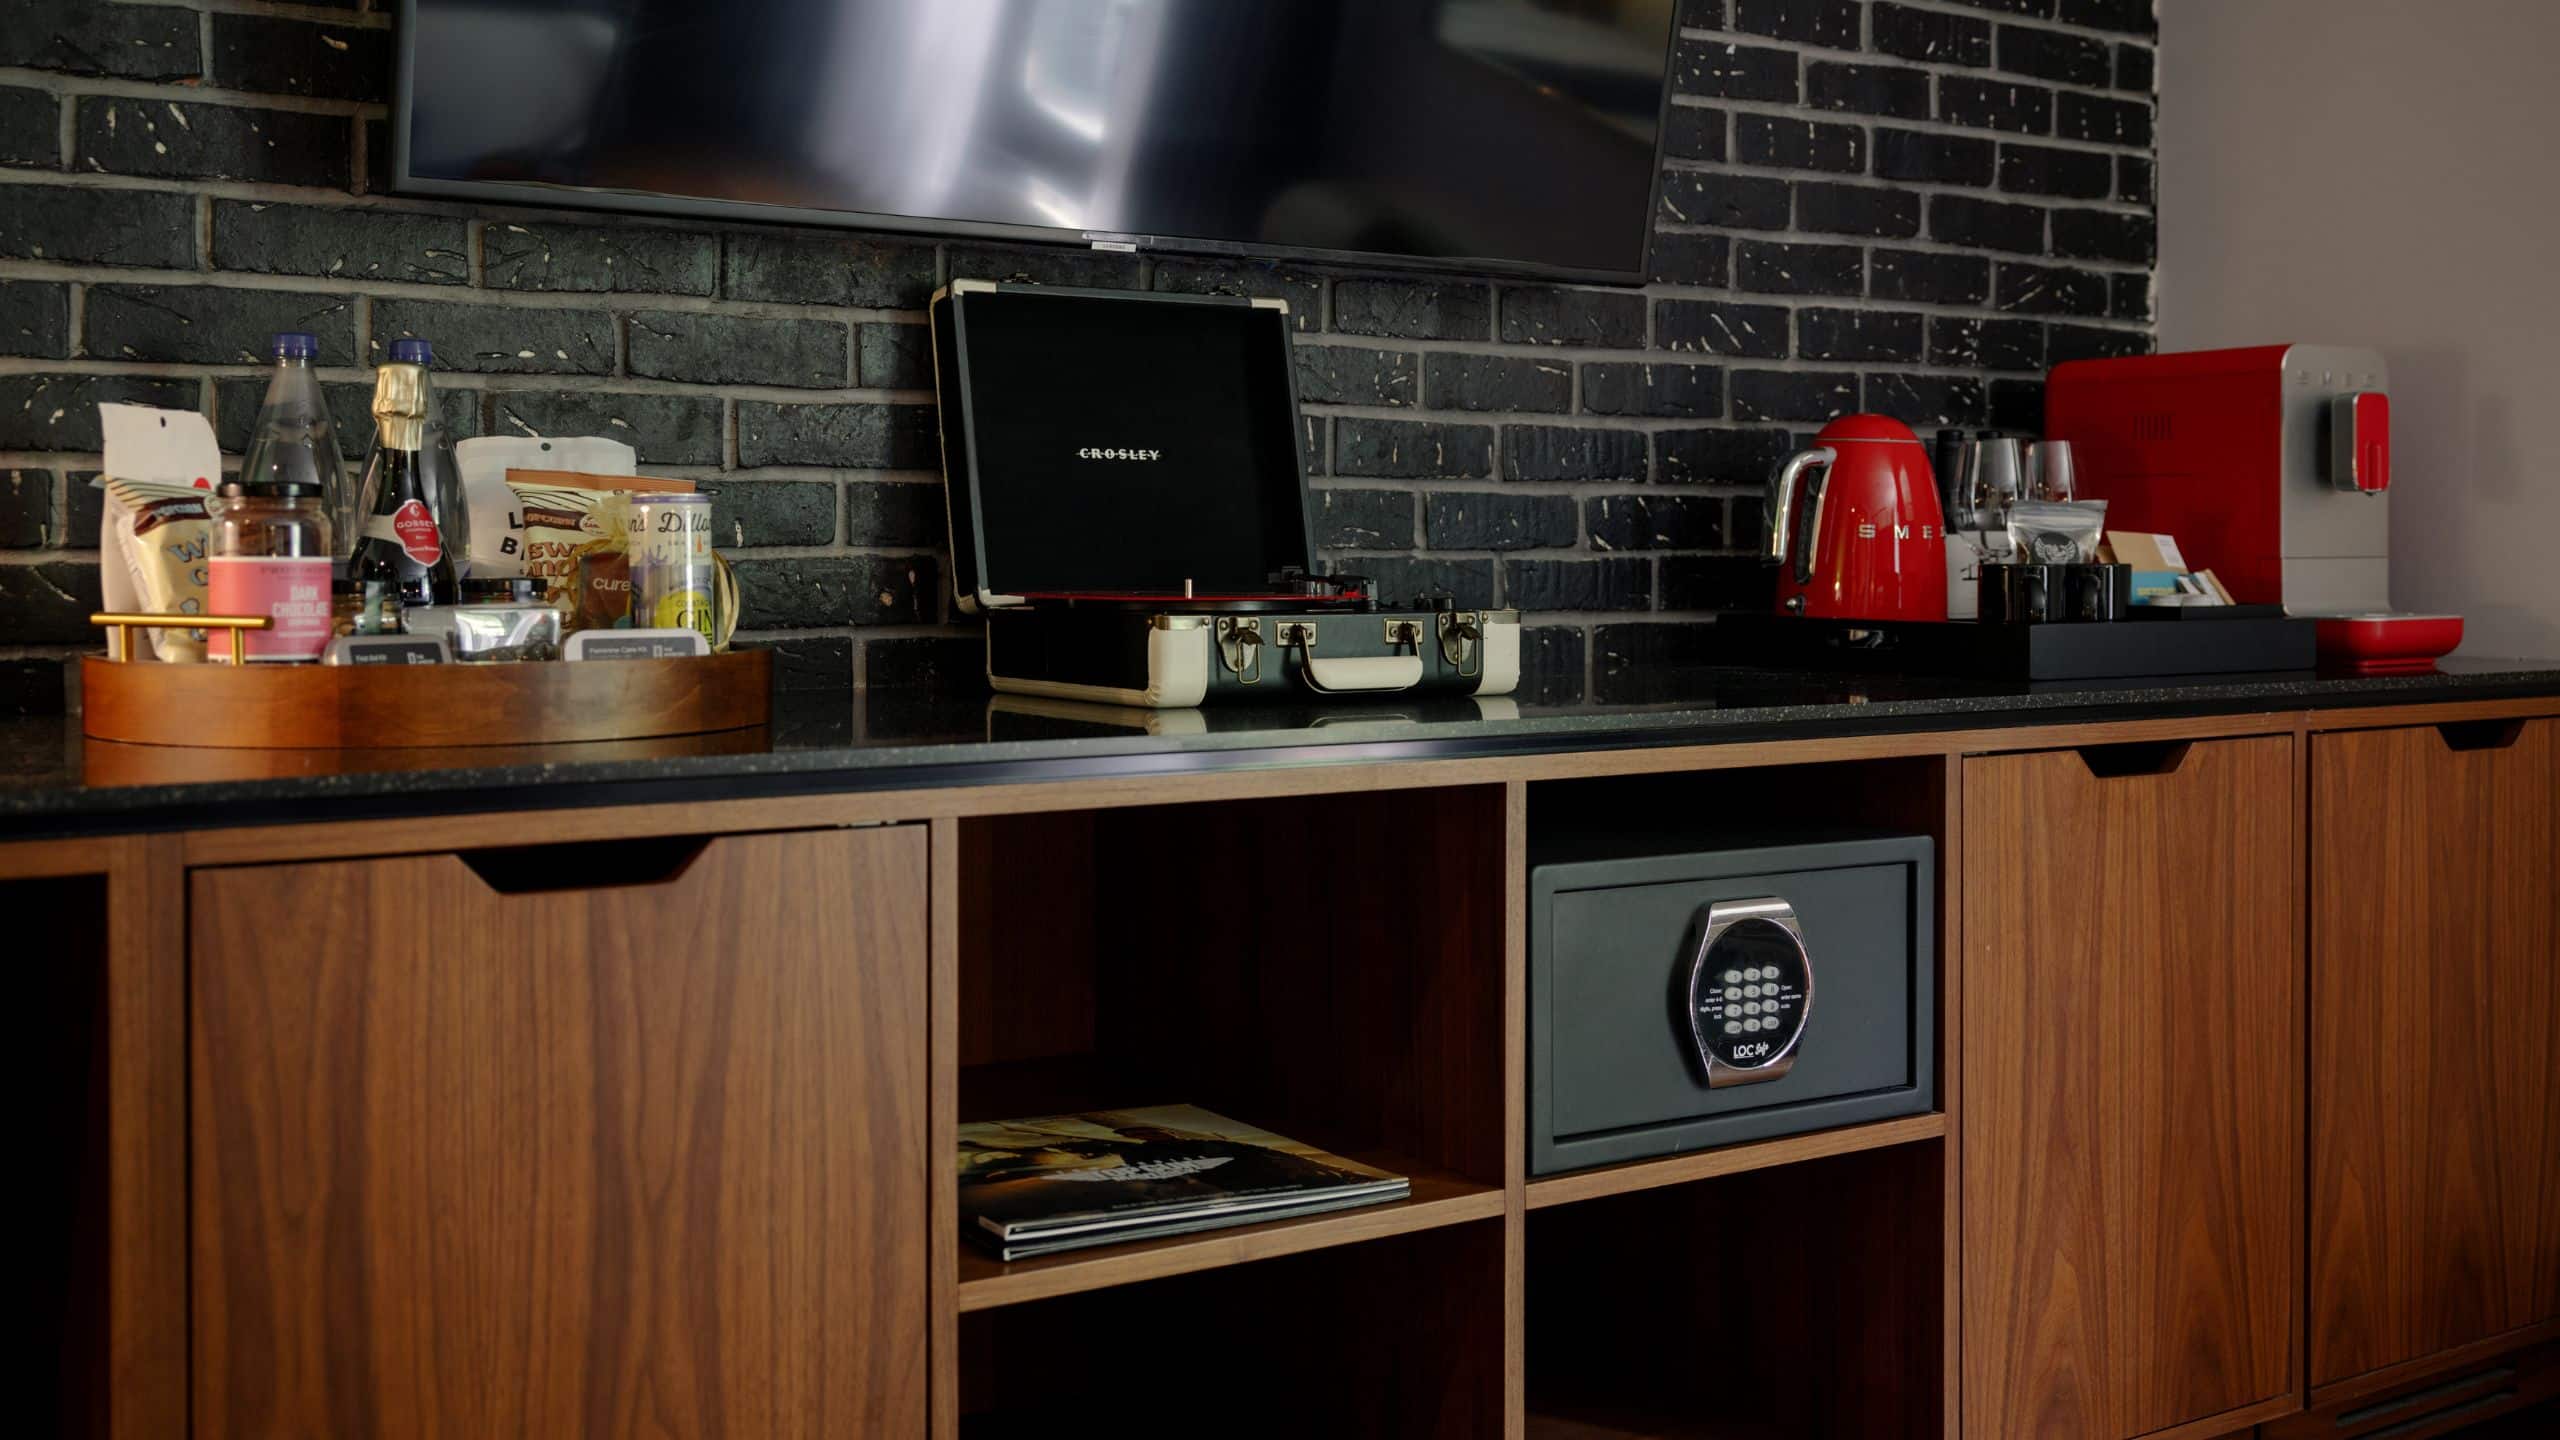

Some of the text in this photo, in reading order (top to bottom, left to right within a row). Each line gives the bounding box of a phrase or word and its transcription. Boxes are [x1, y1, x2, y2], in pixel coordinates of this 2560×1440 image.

[1079, 447, 1159, 461] CROSLEY
[657, 511, 712, 534] Dillo
[592, 576, 632, 592] cure
[1733, 1044, 1755, 1058] LOC
